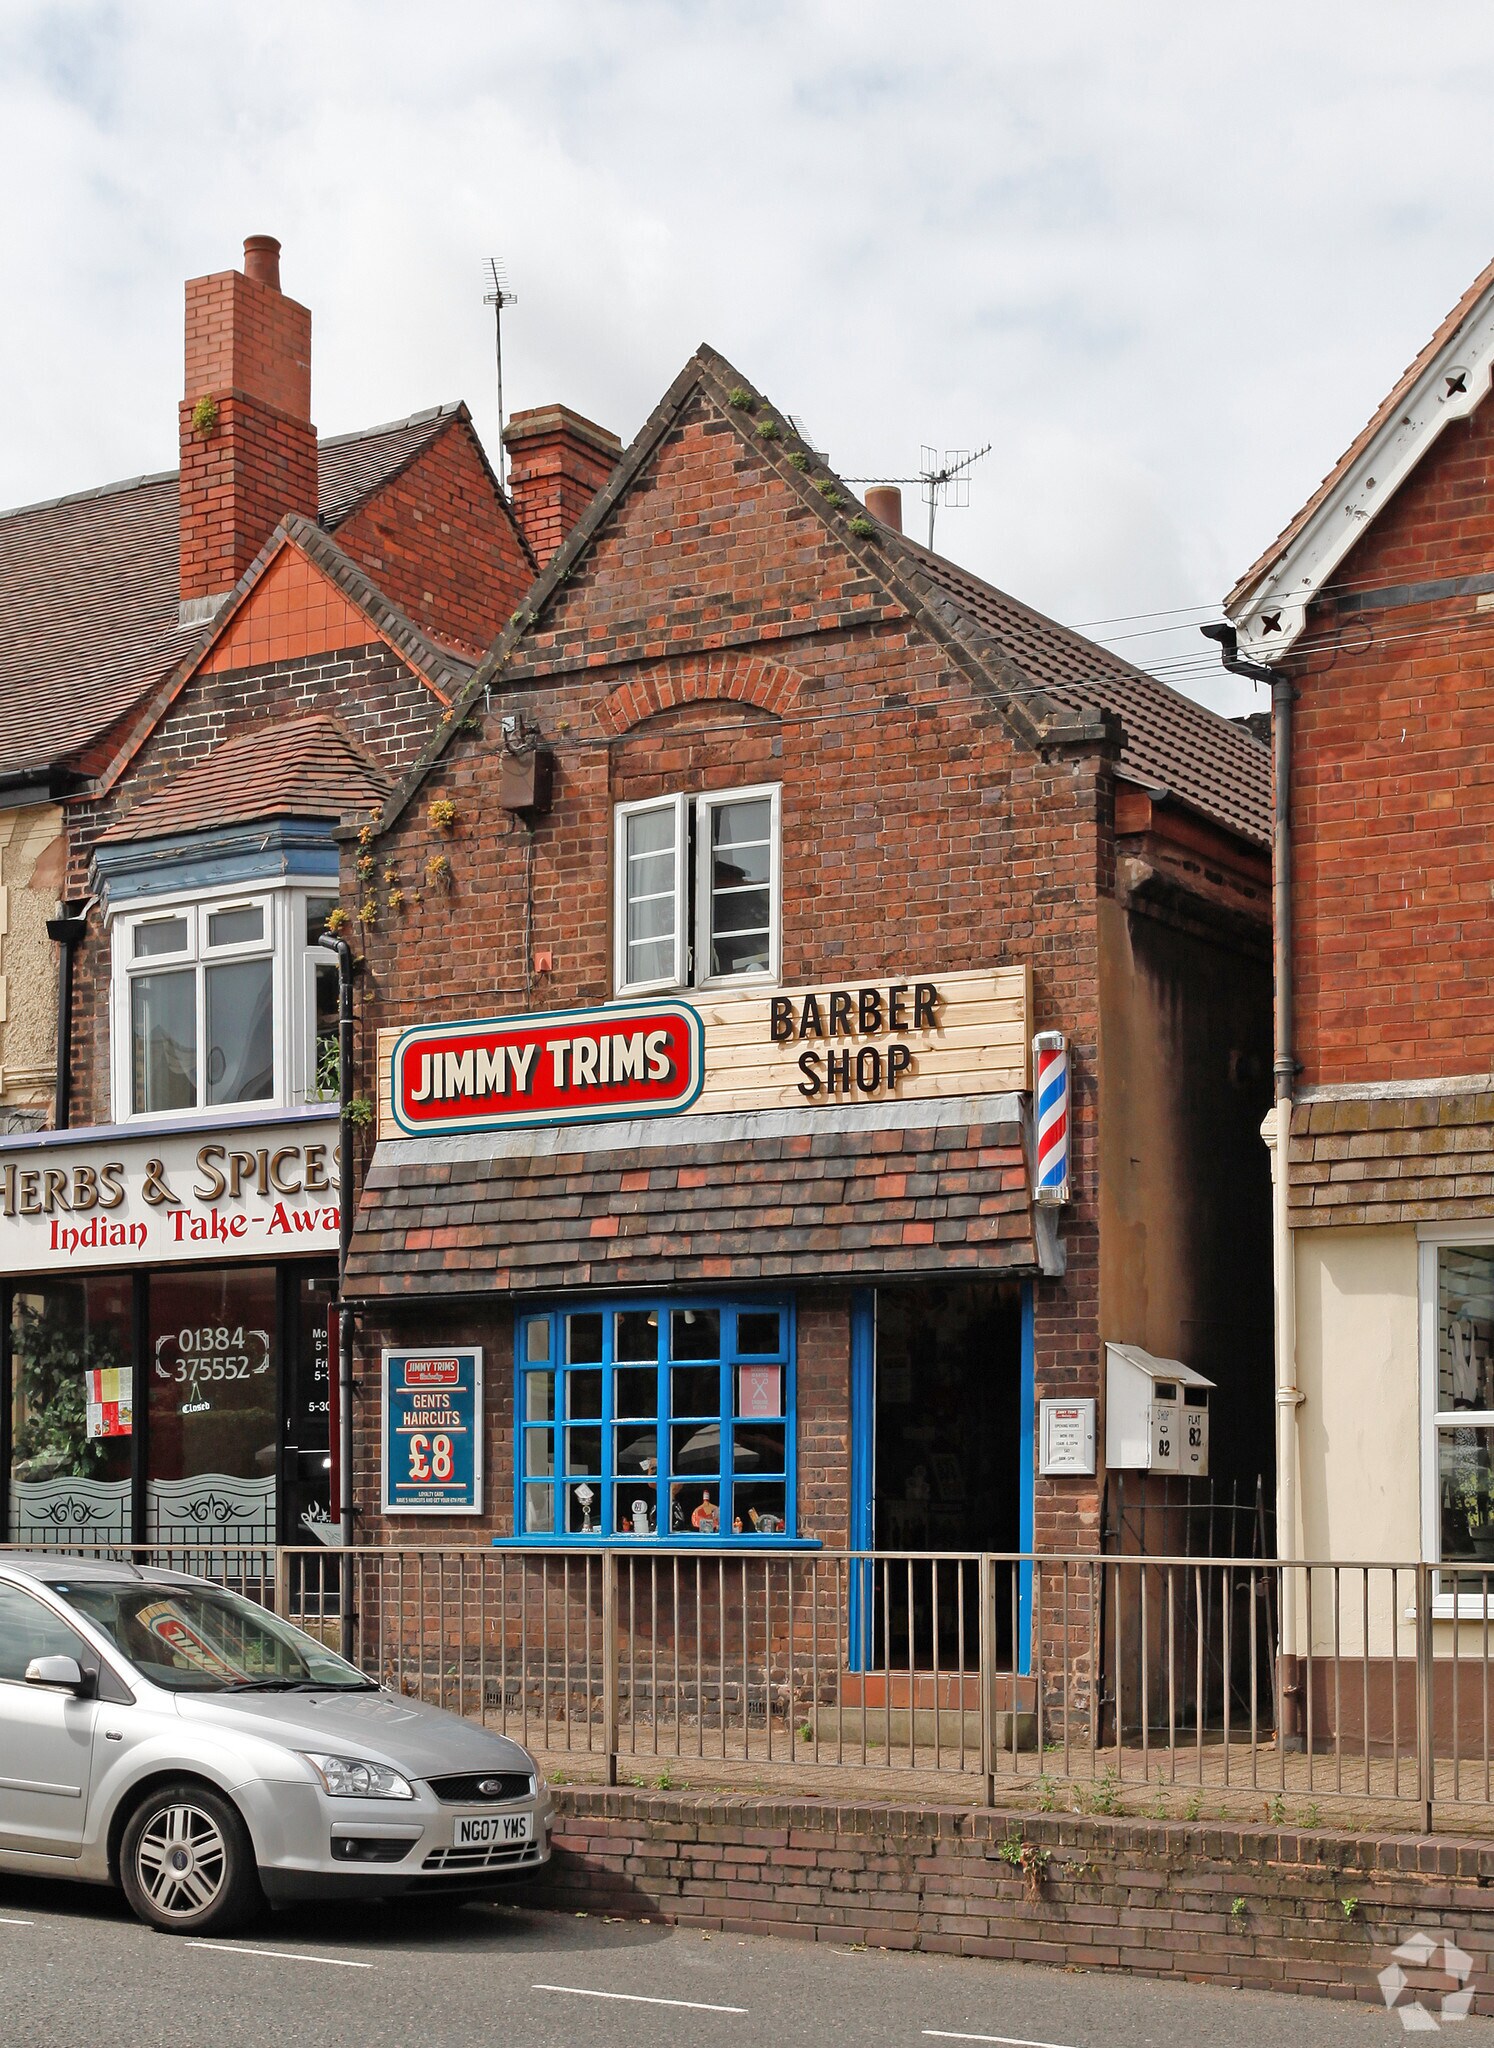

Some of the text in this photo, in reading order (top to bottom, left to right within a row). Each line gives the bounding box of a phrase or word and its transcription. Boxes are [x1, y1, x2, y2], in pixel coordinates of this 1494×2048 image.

[770, 983, 938, 1041] BARBER
[411, 1030, 671, 1102] JIMMY TRIMS
[797, 1044, 910, 1097] SHOP
[141, 1158, 182, 1206] &
[49, 1201, 340, 1256] Indian Take-Awa
[178, 1326, 245, 1352] 01384
[312, 1328, 328, 1338] Mo
[174, 1355, 250, 1383] 375552
[408, 1361, 455, 1372] JIMMY TRIMS
[181, 1401, 211, 1414] Closed
[413, 1394, 450, 1408] GENTS
[403, 1411, 460, 1425] HAIRCUTS
[1188, 1414, 1201, 1426] FLAT
[1158, 1439, 1170, 1457] 82
[1188, 1427, 1202, 1447] 82
[409, 1434, 453, 1479] £8
[460, 1817, 526, 1842] NG07 YMS
